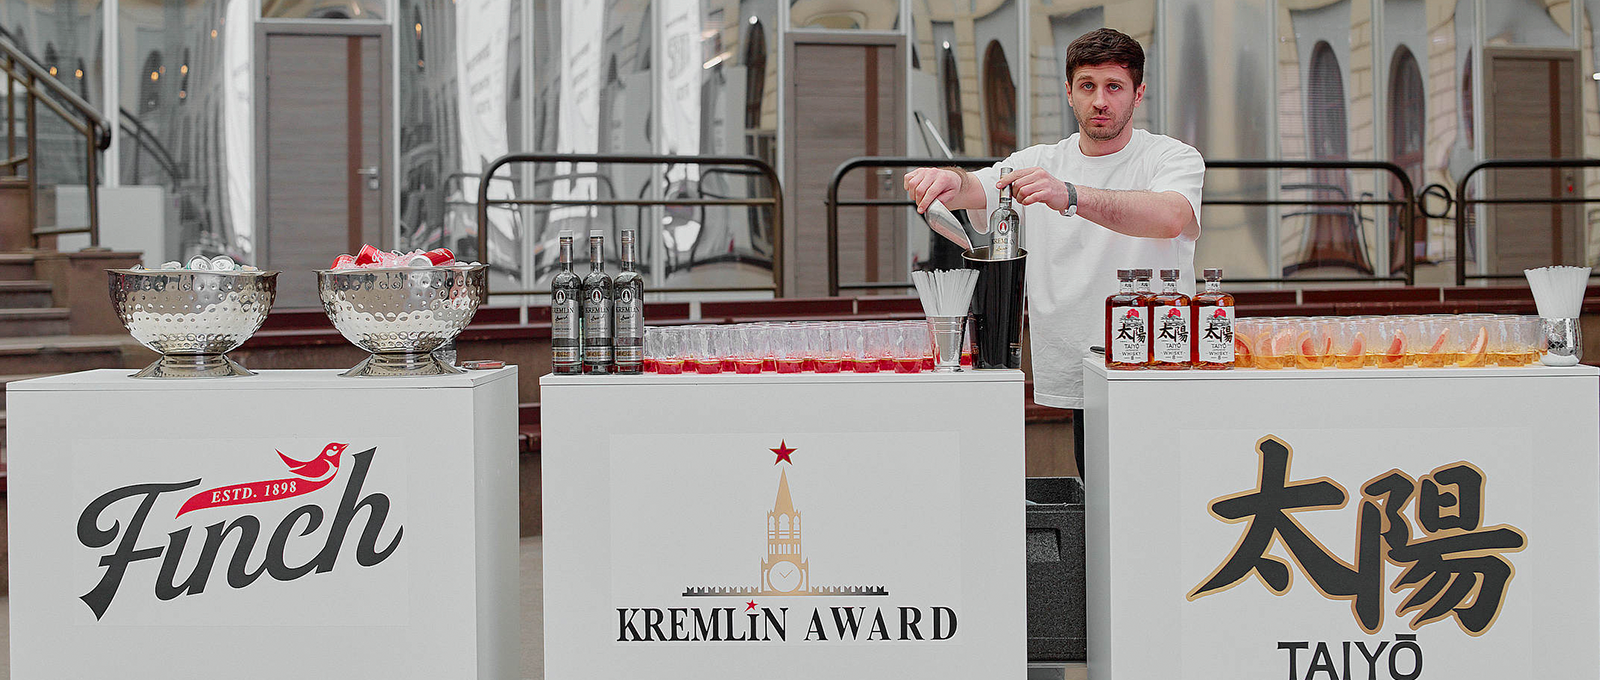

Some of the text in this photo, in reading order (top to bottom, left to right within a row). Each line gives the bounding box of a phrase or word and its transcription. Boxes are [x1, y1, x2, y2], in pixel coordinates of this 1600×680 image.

[1115, 322, 1147, 344] 太陽
[1157, 322, 1189, 343] 太陽
[1202, 322, 1234, 344] 太陽
[211, 480, 297, 503] ESTD. 1898
[77, 446, 403, 621] Finch
[1186, 434, 1528, 637] 太陽
[804, 606, 958, 642] AWARD
